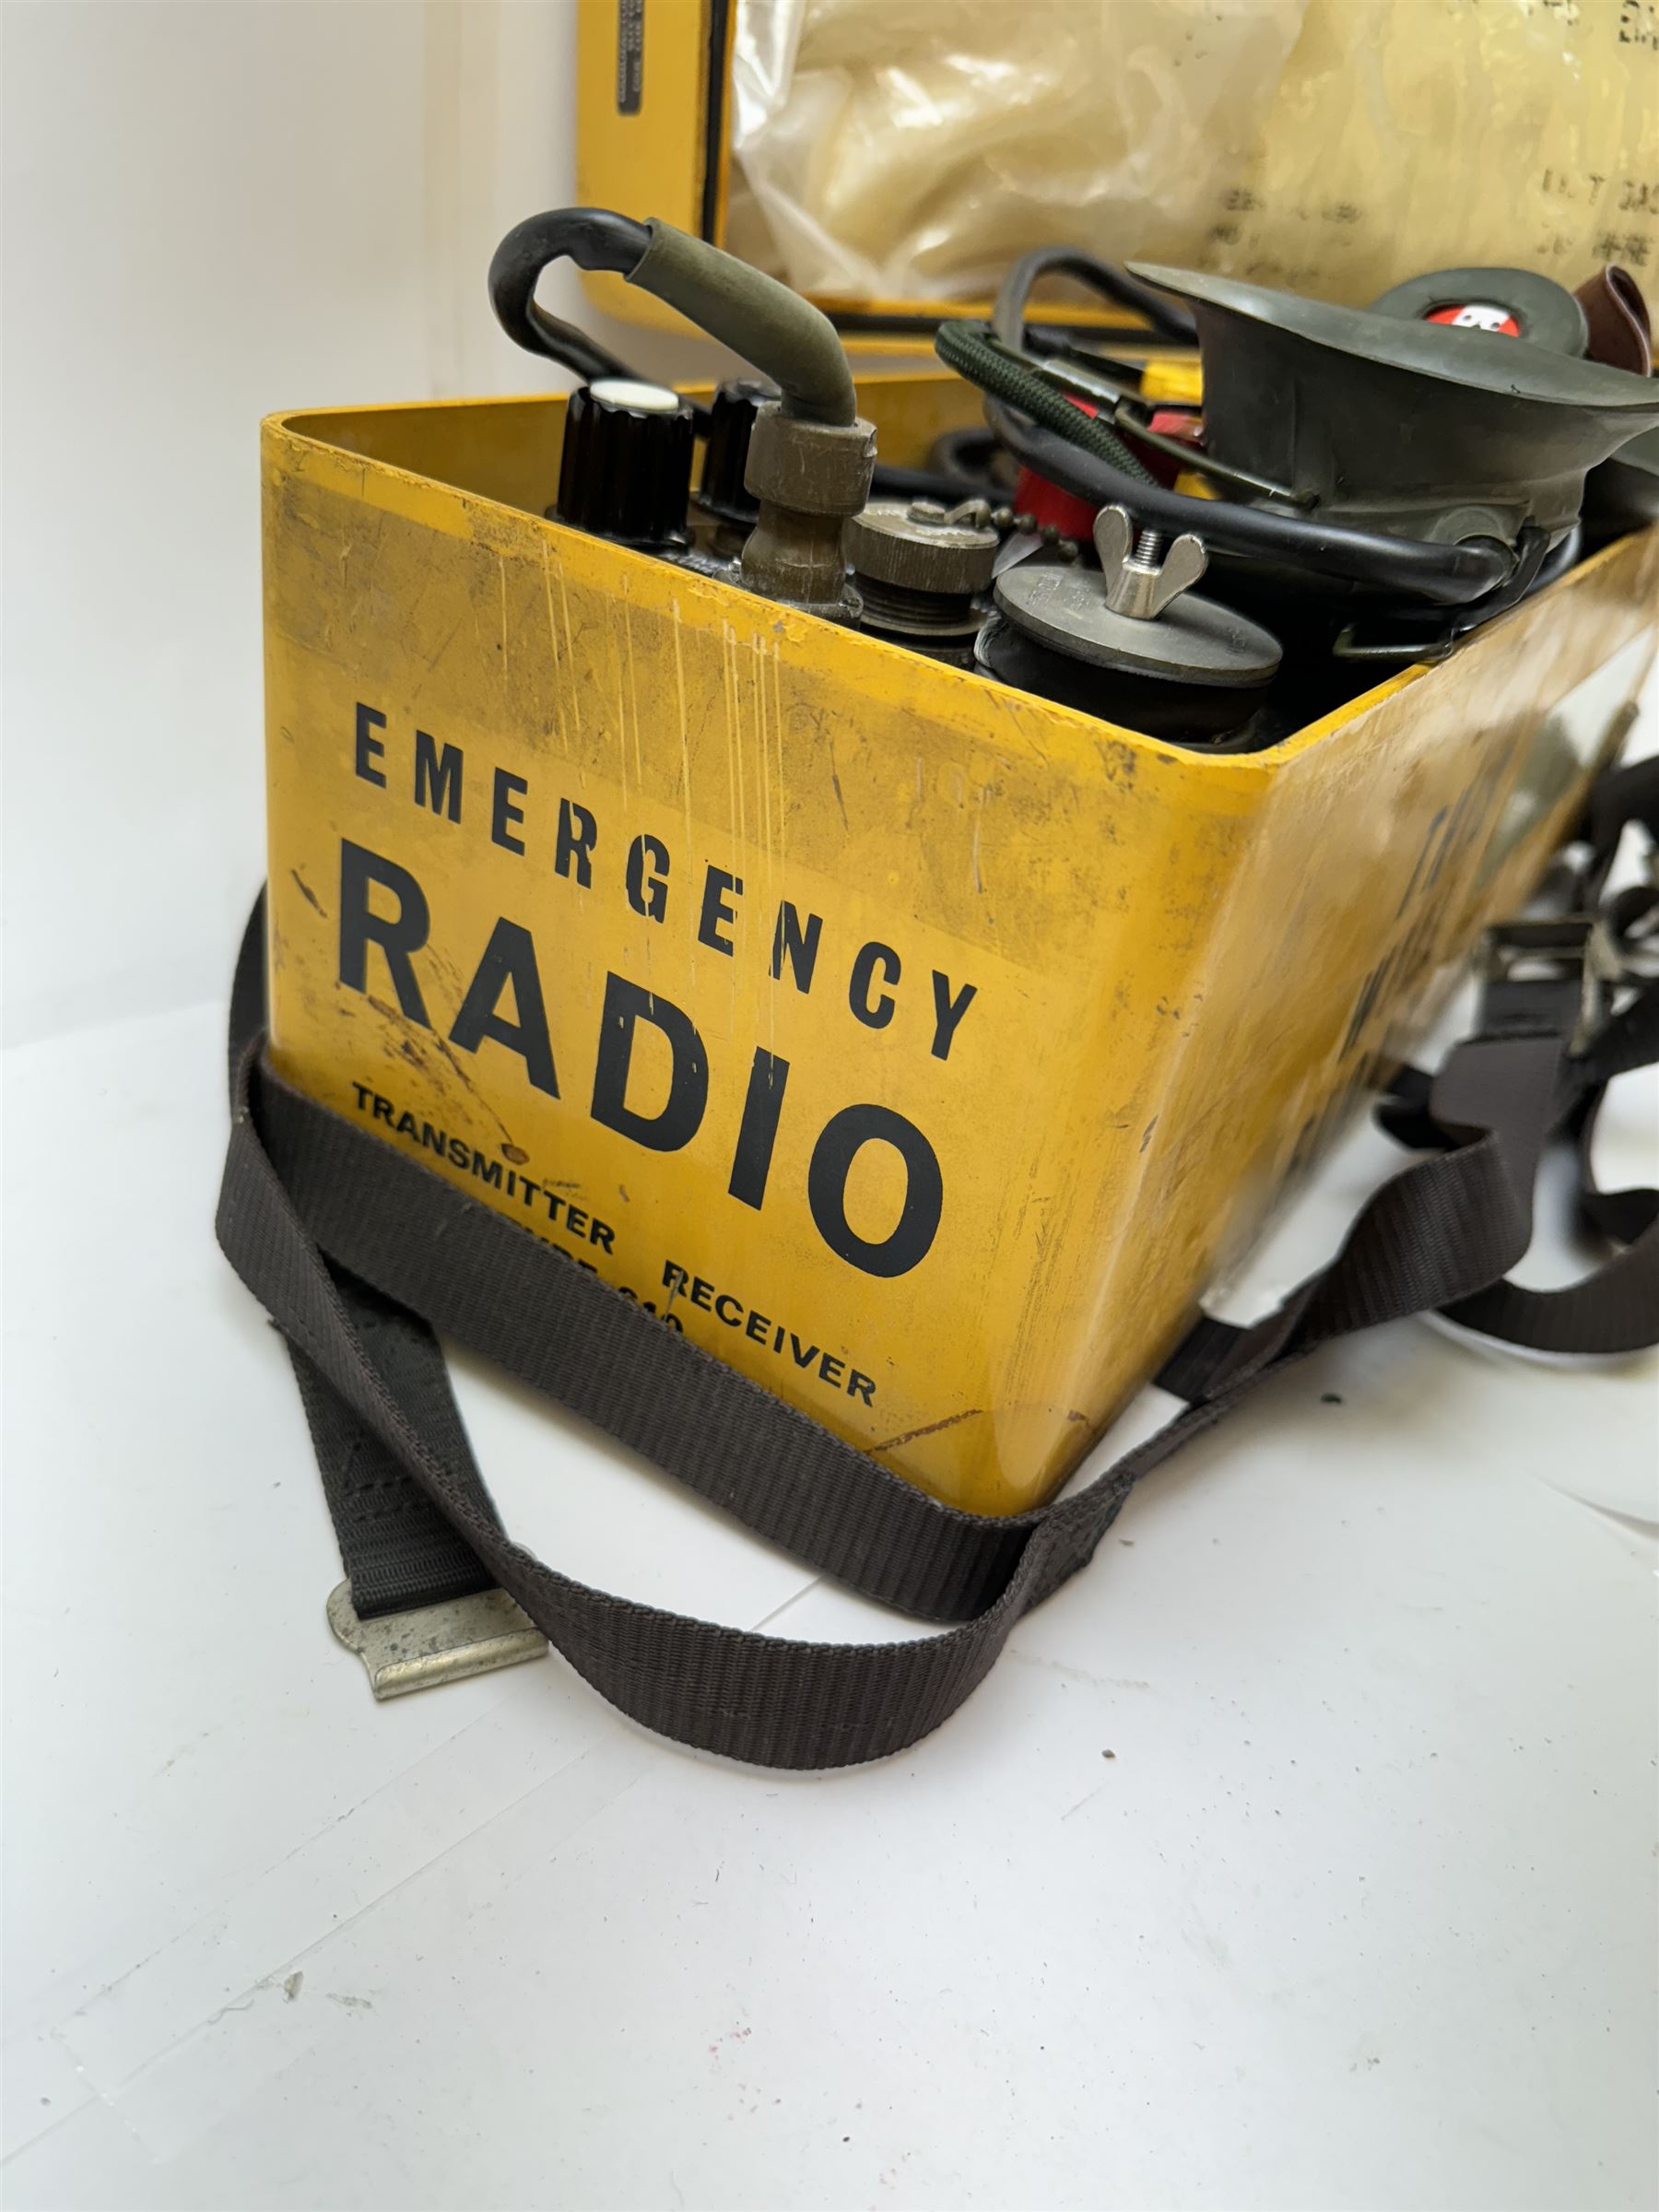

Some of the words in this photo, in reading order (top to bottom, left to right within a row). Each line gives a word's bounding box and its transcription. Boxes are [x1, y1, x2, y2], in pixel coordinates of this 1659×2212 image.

[338, 838, 944, 1278] RADIO
[355, 701, 978, 1061] EMERGENCY
[353, 1081, 616, 1254] TRANSMITTER
[662, 1260, 876, 1407] RECEIVER
